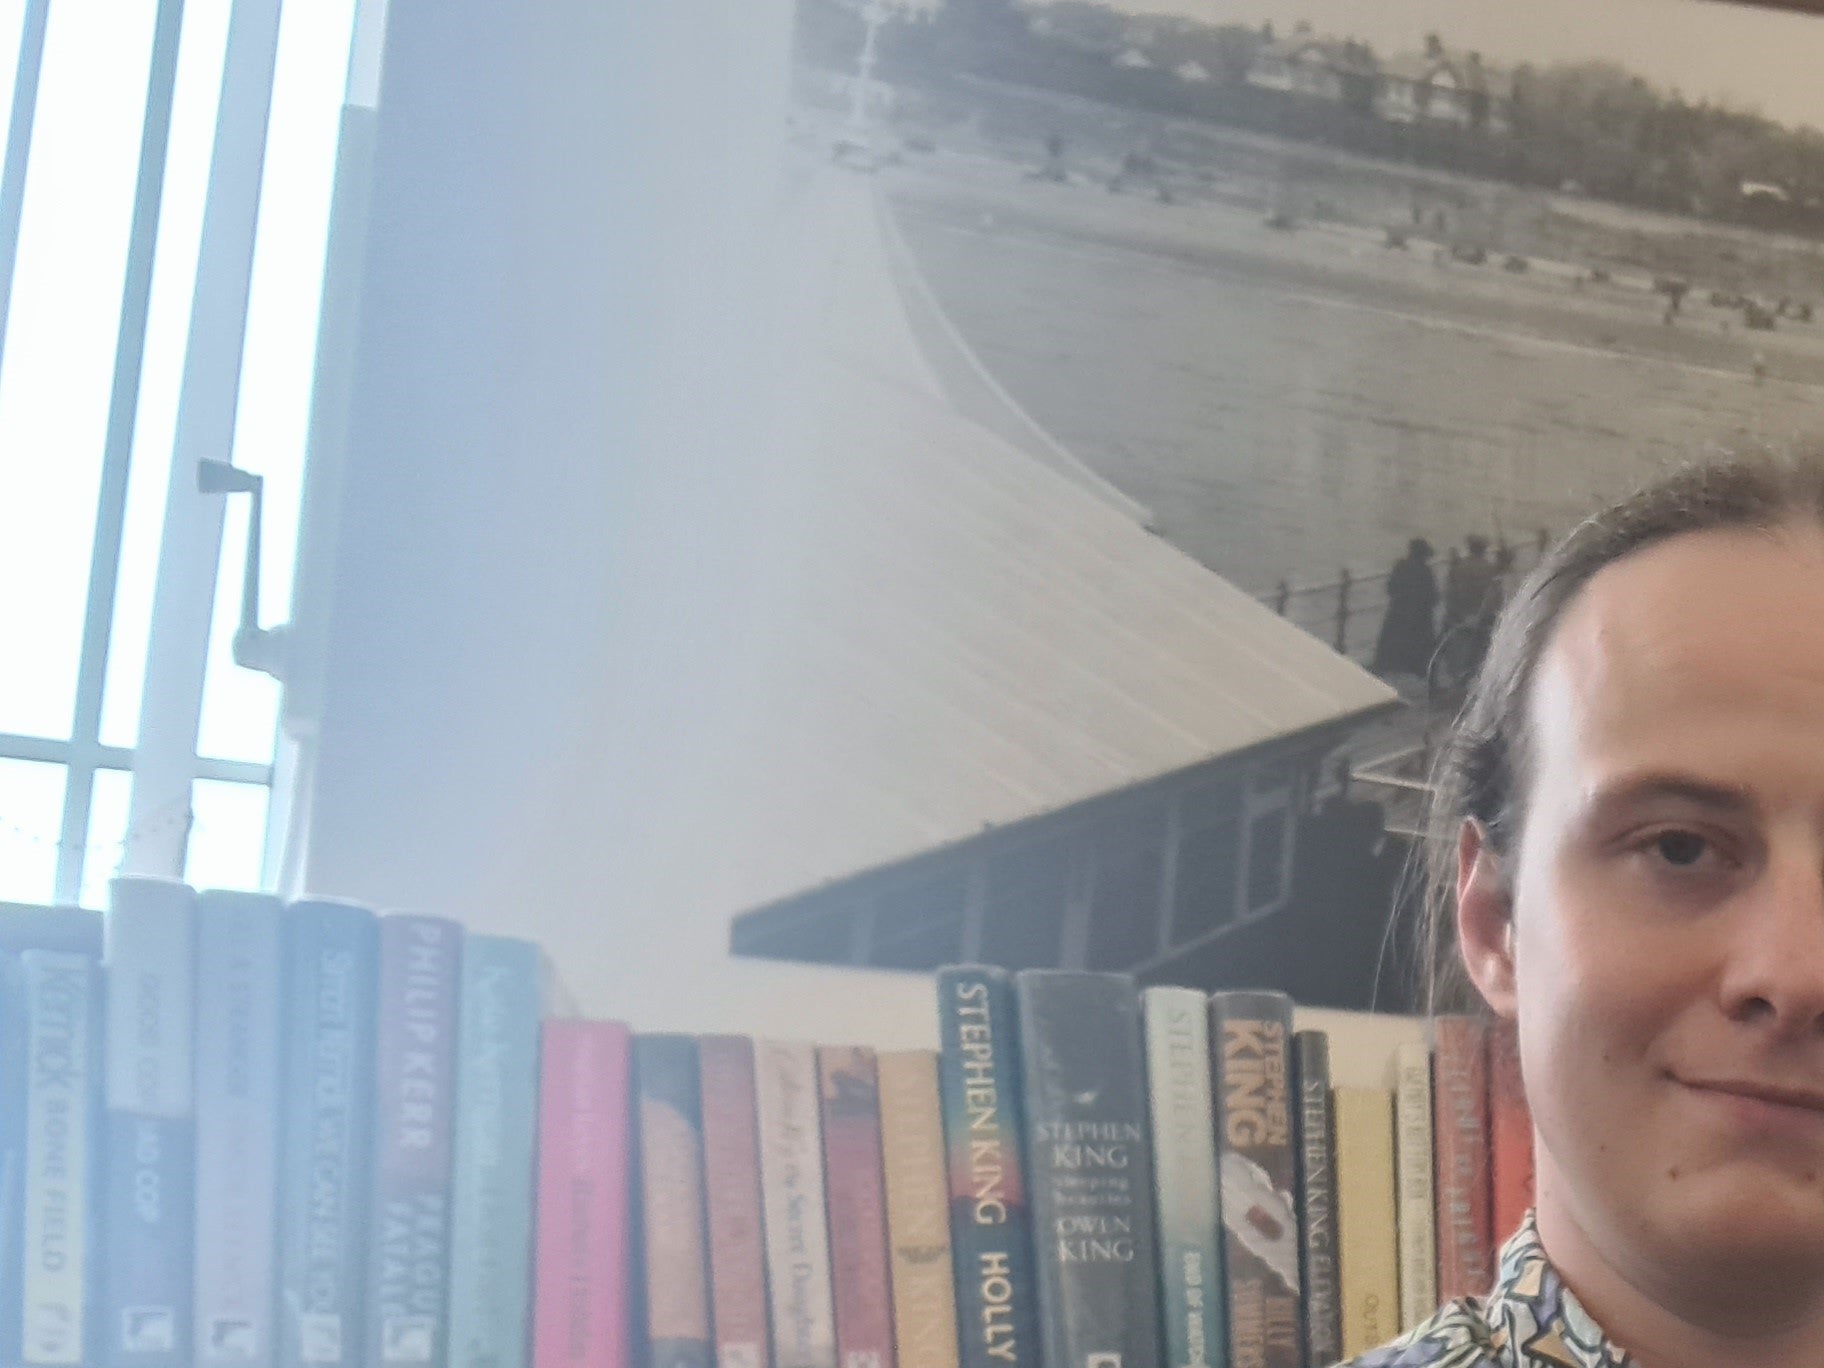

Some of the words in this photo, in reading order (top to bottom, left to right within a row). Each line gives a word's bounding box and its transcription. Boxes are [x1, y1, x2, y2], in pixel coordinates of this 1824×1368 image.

[403, 921, 441, 1044] PHILIP
[399, 1050, 435, 1149] KERR
[956, 982, 998, 1130] STEPHEN
[1165, 1008, 1198, 1144] STEPHEN
[1223, 1019, 1264, 1145] KING
[1261, 1019, 1288, 1145] STEPHEN
[971, 1139, 1006, 1225] KING
[1037, 1121, 1140, 1142] STEPHEN
[1052, 1143, 1129, 1169] KING
[1303, 1080, 1329, 1184] STEPHEN
[1058, 1238, 1134, 1262] KING
[1307, 1186, 1331, 1250] KING
[981, 1254, 1016, 1361] HOLLY
